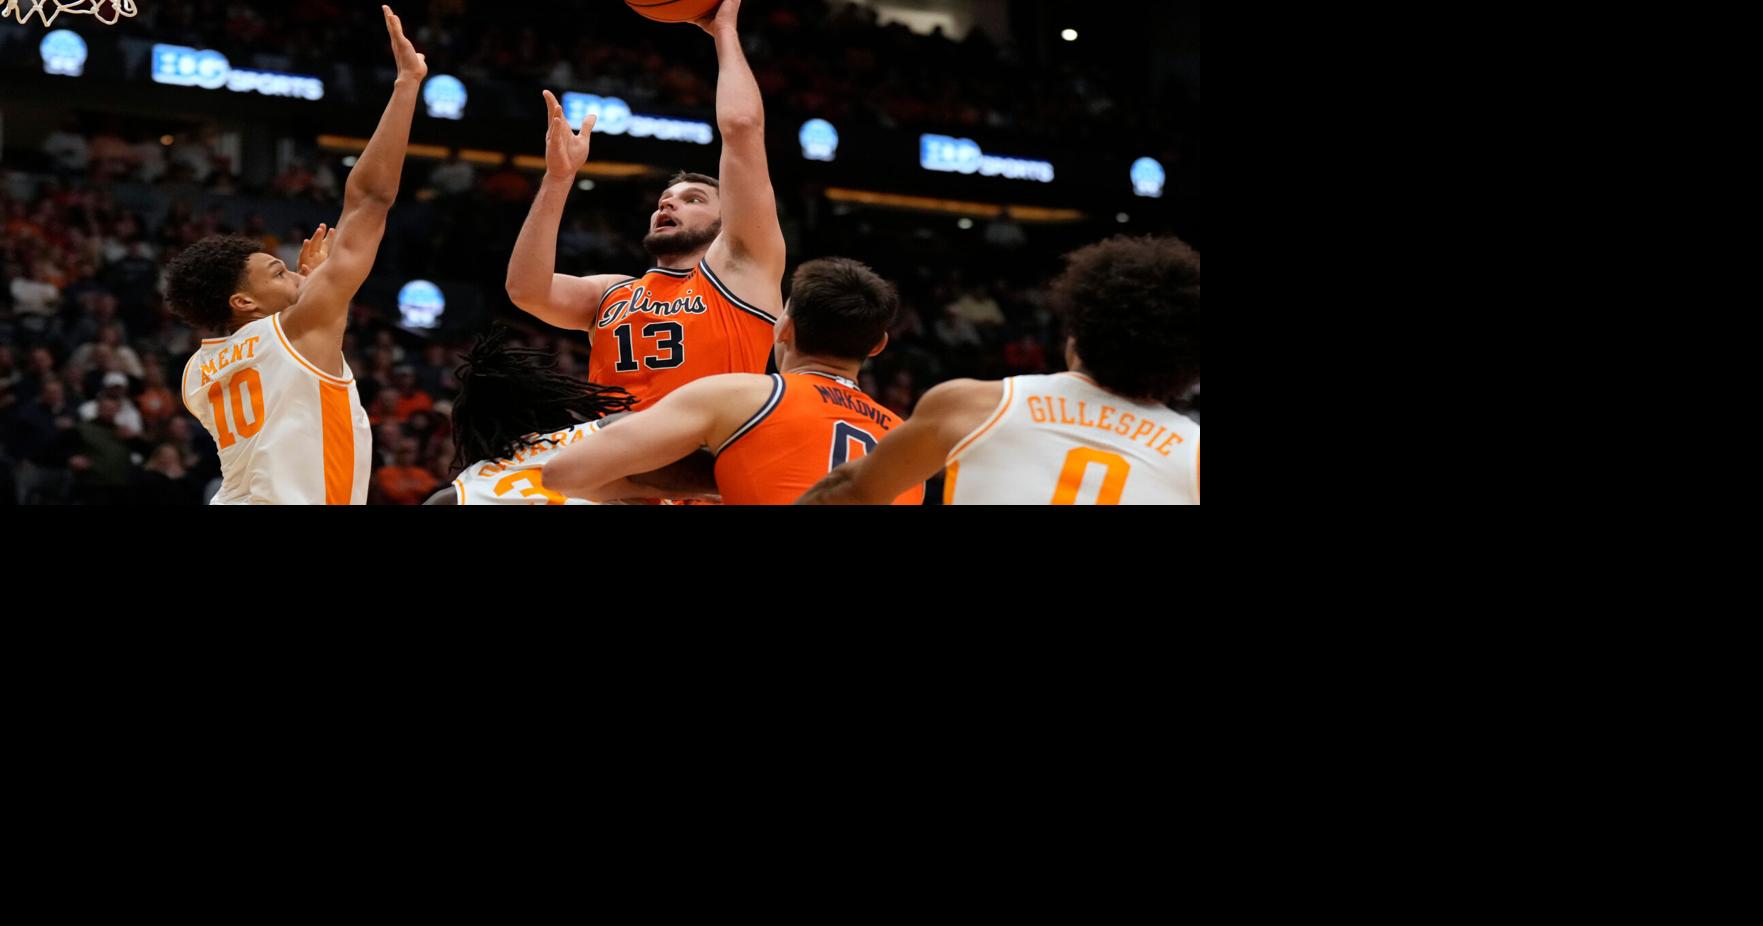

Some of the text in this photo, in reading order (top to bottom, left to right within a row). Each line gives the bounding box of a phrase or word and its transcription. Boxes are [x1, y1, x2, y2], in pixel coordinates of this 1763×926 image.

[612, 320, 685, 372] 13
[208, 368, 265, 449] 10
[813, 384, 891, 430] MIRKOVIC
[1027, 394, 1184, 456] GILLESPIE
